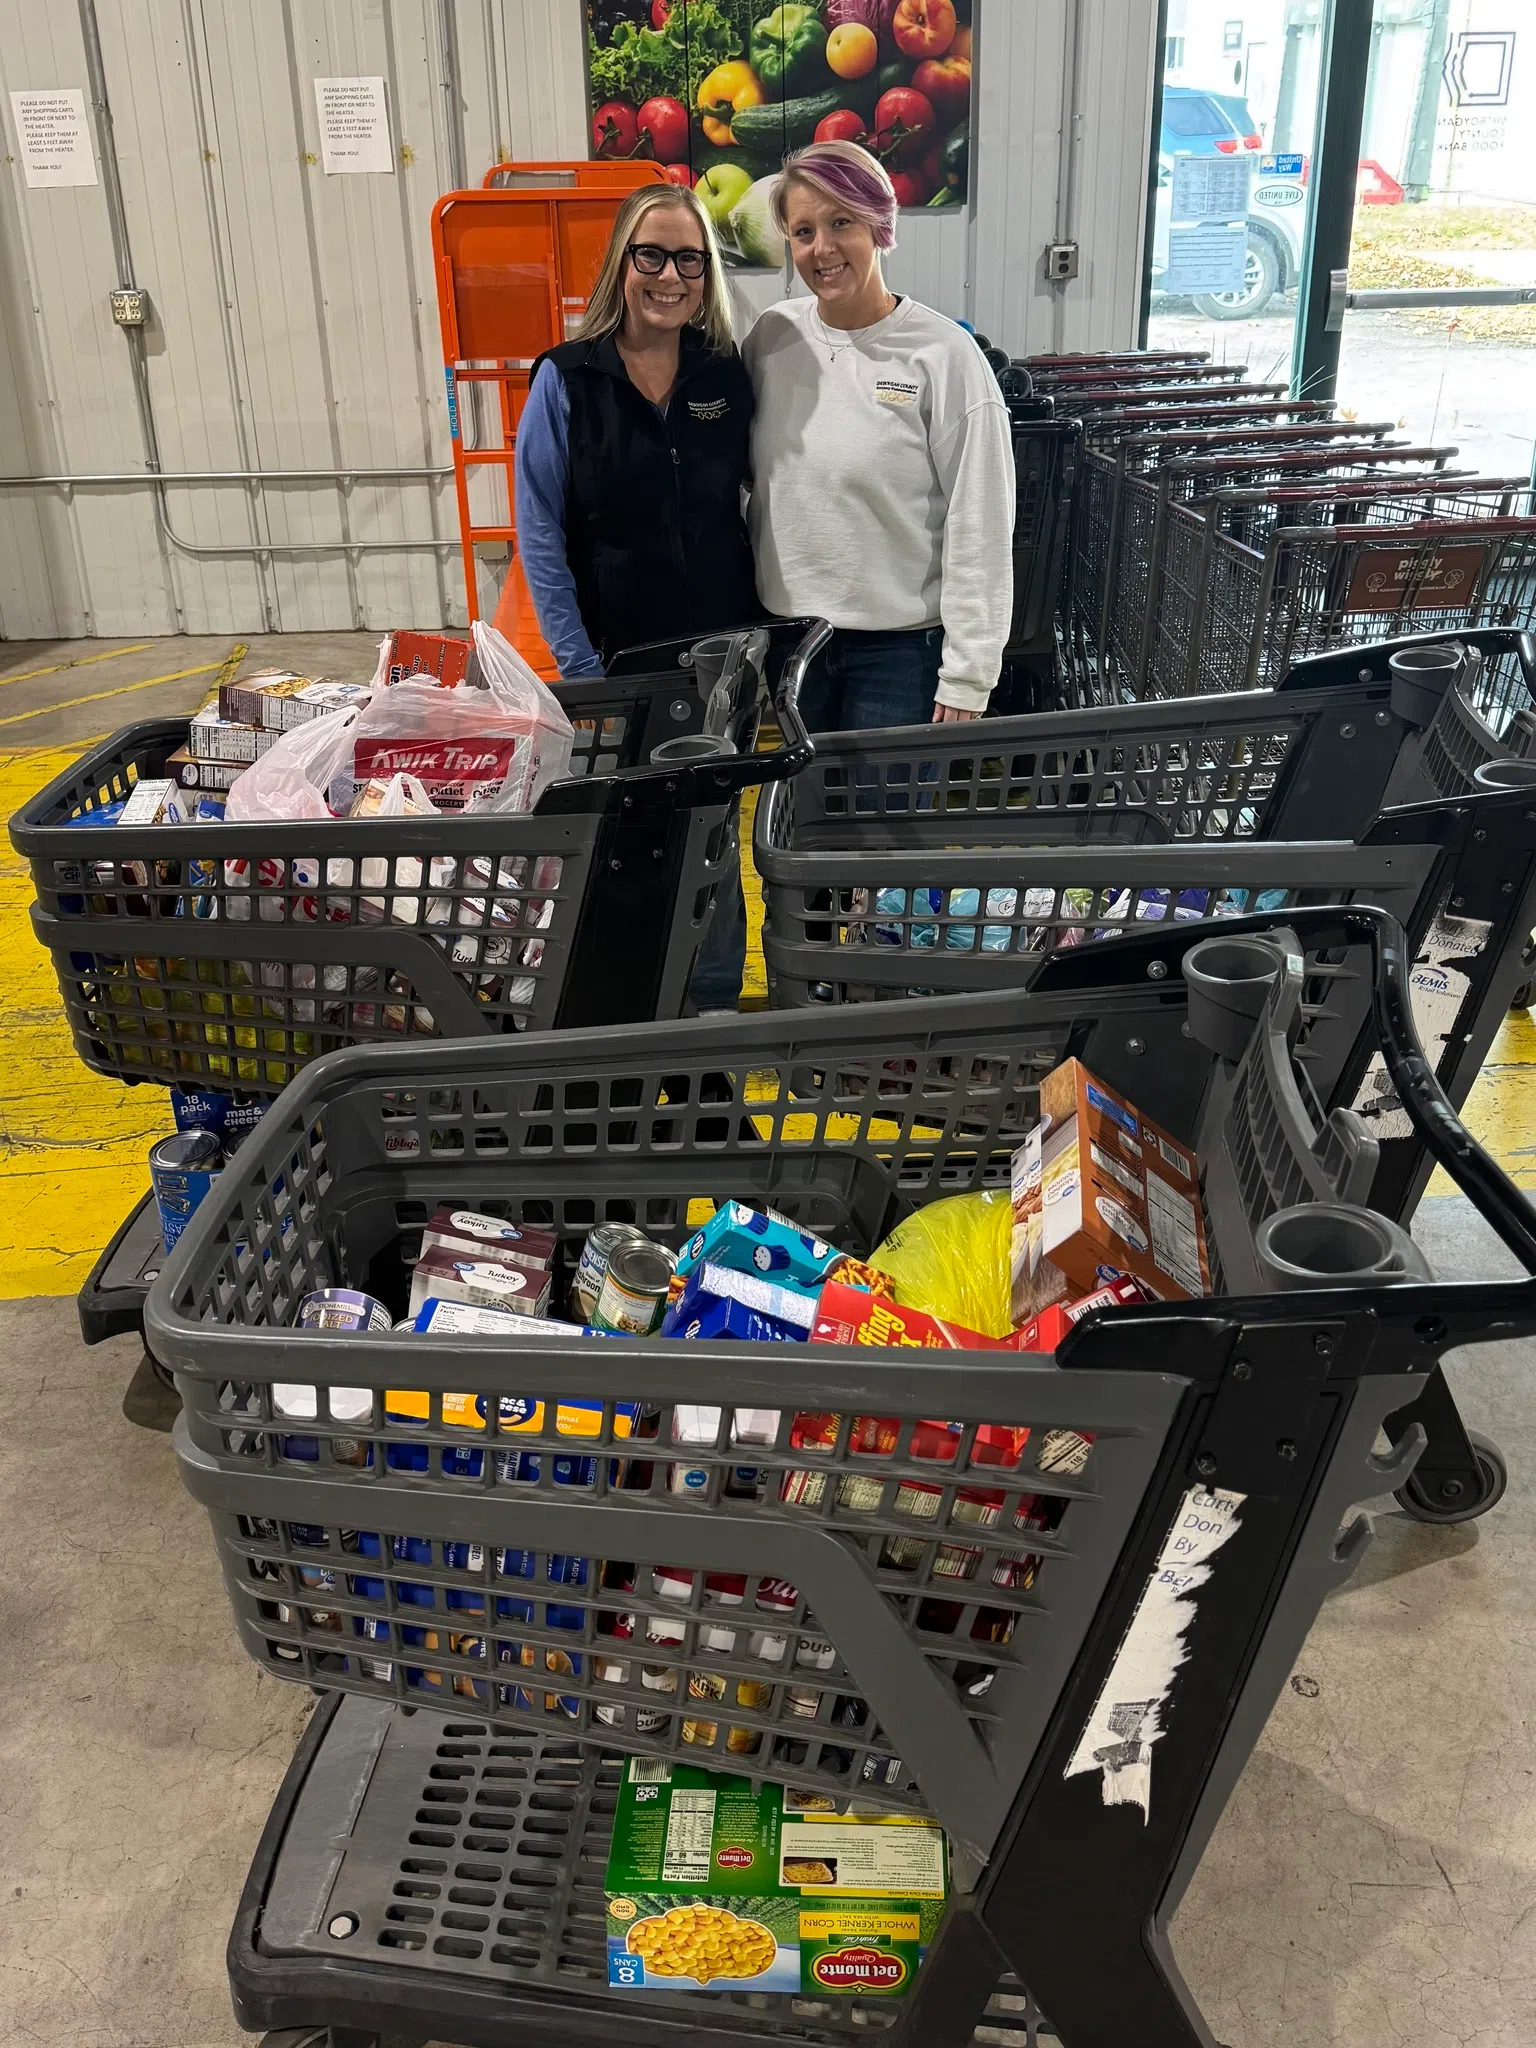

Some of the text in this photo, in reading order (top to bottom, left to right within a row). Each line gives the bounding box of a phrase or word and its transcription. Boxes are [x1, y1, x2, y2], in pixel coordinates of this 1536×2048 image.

[446, 374, 458, 432] HOLD HERE
[370, 747, 498, 770] KWIK TRIP
[429, 786, 464, 796] Outlet
[1411, 973, 1450, 990] BEMIS
[184, 1095, 200, 1104] 18
[180, 1102, 212, 1116] pack
[457, 1217, 489, 1231] Turkey
[487, 1269, 520, 1282] Turkey
[441, 1304, 466, 1312] Nutrition
[310, 1313, 353, 1323] IODIZED
[448, 1395, 467, 1405] CHEESE
[1069, 1456, 1084, 1468] 110
[1173, 1536, 1199, 1556] By
[799, 1639, 833, 1654] OUP
[636, 1718, 661, 1728] OUP
[803, 1918, 916, 1930] WHOLE KERNEL CORN
[857, 1935, 880, 1944] Fresh
[613, 1957, 639, 1966] CANS
[842, 1954, 876, 1964] Quality
[618, 1967, 636, 1983] 8
[820, 1963, 899, 1978] Del Monte
